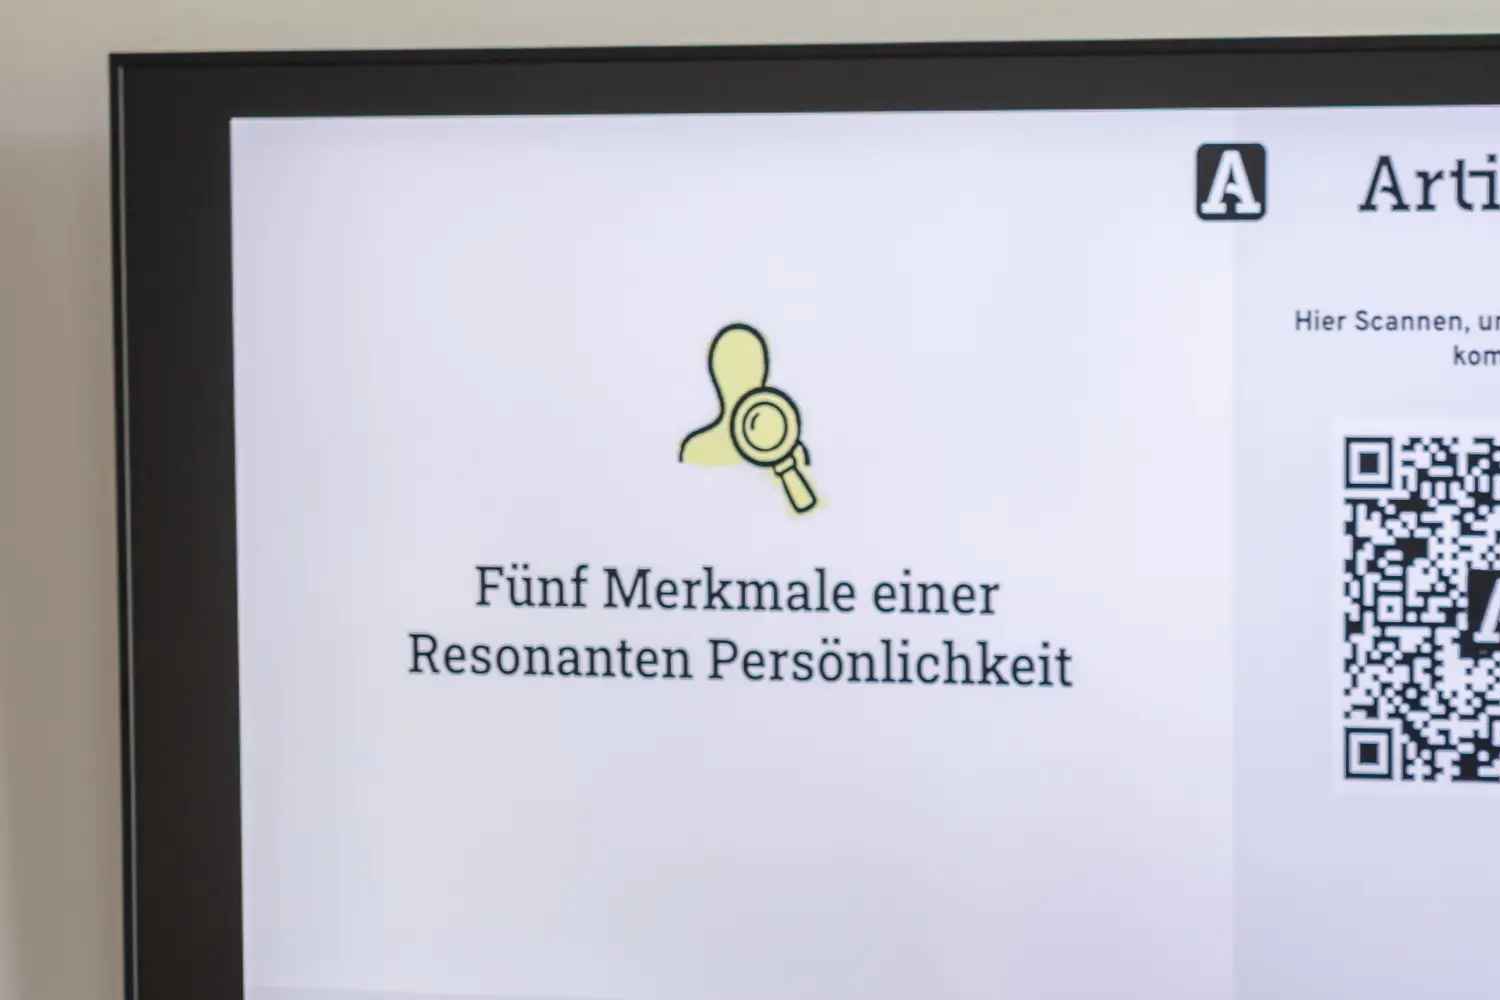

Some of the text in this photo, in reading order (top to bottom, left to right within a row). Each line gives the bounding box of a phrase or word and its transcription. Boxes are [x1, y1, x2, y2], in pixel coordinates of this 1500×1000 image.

[1200, 148, 1262, 216] A
[1294, 309, 1348, 333] Hier
[1354, 309, 1471, 335] Scannen,
[474, 562, 1001, 616] Fünf Merkmale einer
[407, 632, 1074, 689] Resonanten Persönlichkeit
